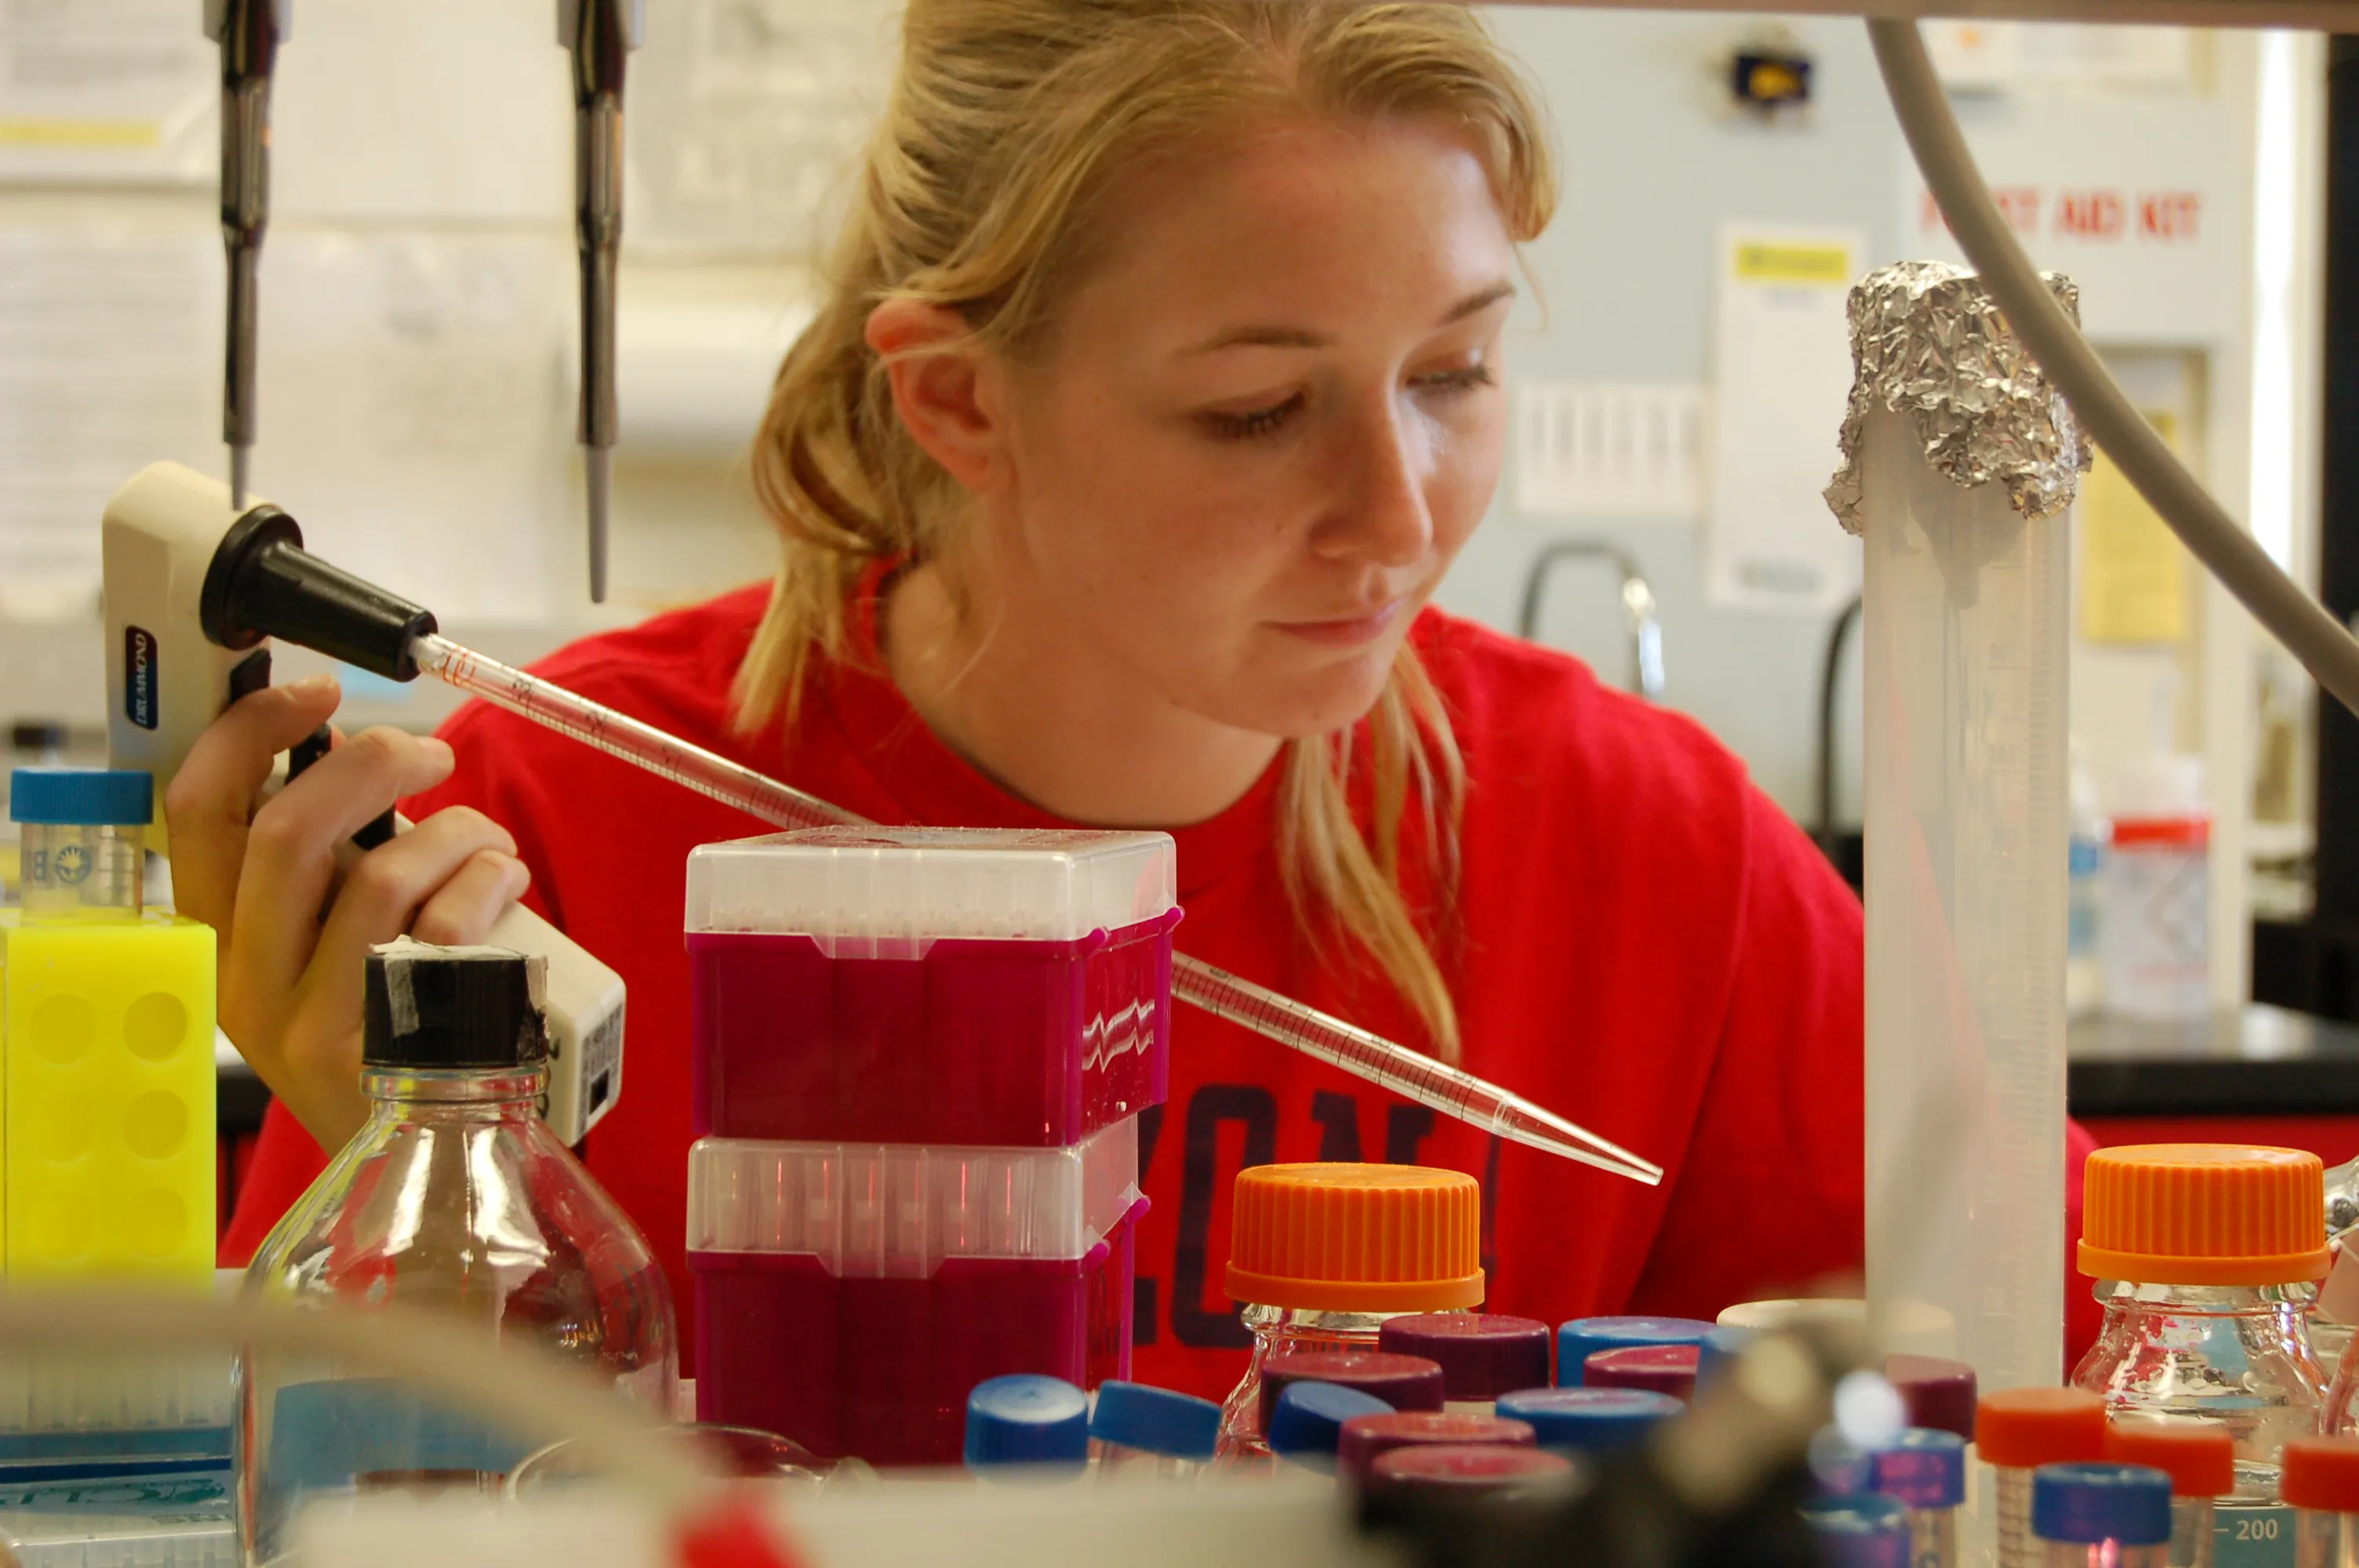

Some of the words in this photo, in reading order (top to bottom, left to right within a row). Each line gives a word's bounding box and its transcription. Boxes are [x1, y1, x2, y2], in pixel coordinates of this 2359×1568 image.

[2055, 189, 2121, 238] AID
[2138, 191, 2201, 238] KIT
[2235, 1519, 2278, 1541] 200
